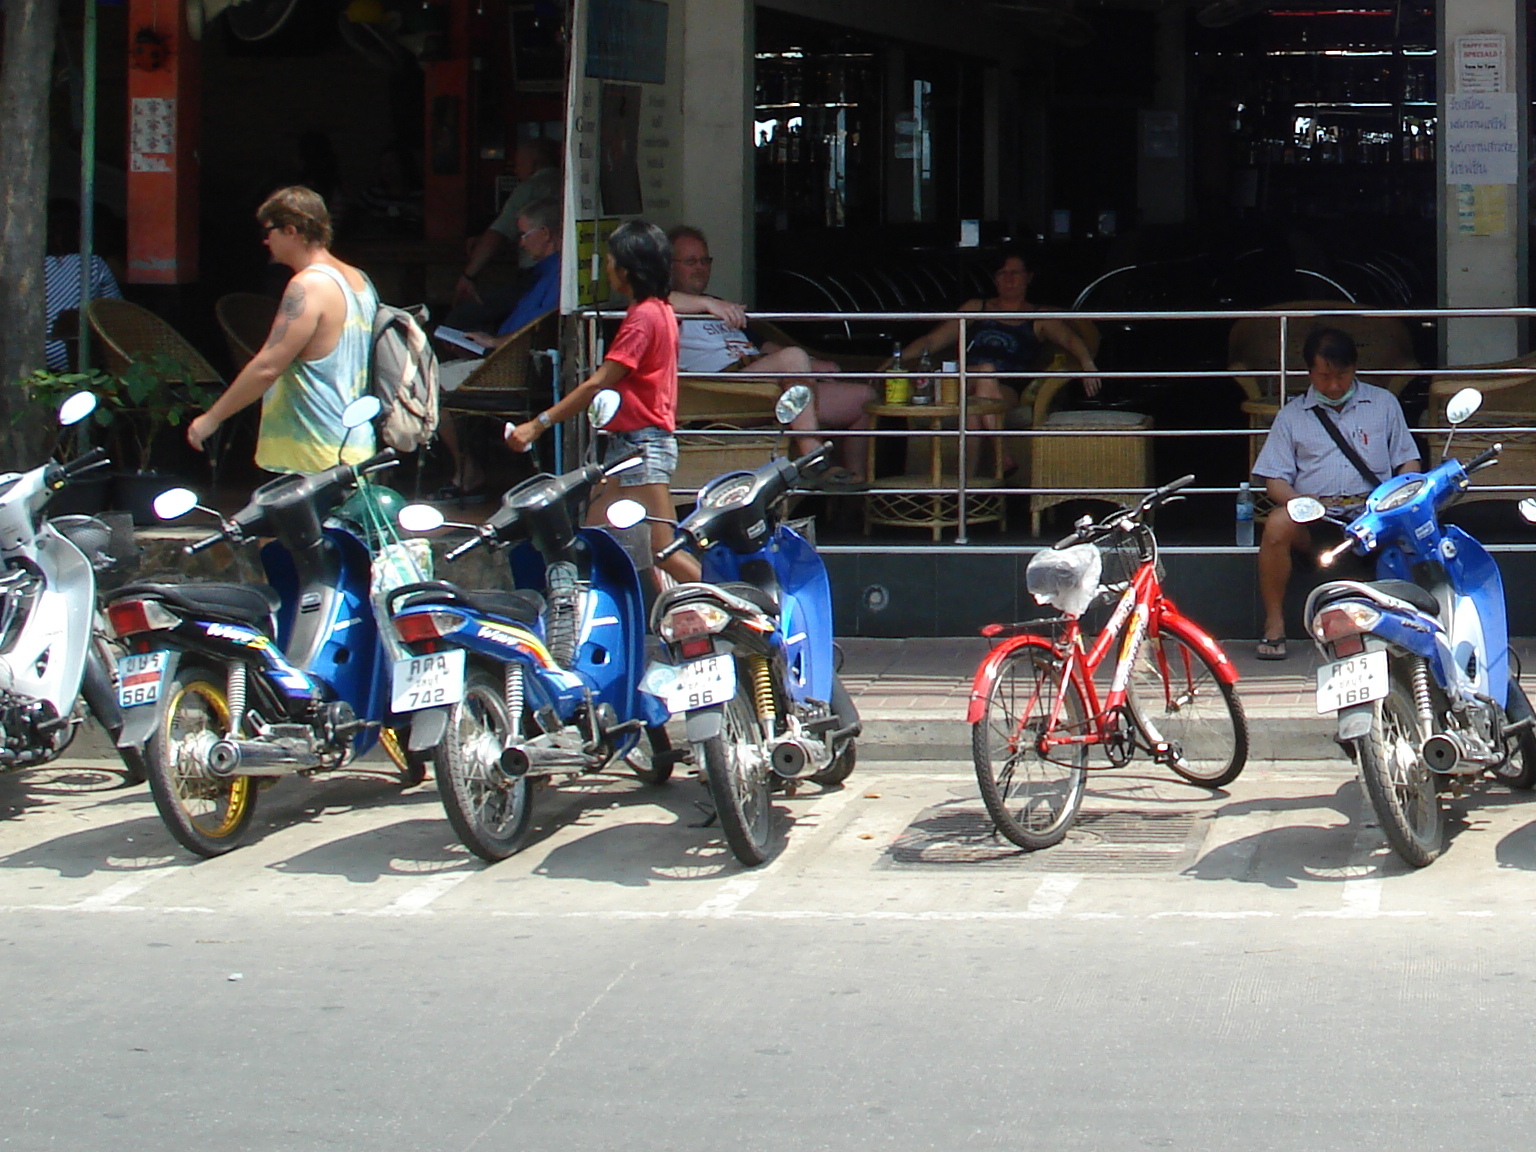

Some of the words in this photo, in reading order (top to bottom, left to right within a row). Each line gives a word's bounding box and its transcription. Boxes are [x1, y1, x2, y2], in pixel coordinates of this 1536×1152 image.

[122, 686, 157, 705] 564
[408, 688, 445, 708] 742
[688, 690, 714, 707] 96
[1336, 687, 1370, 706] 168
